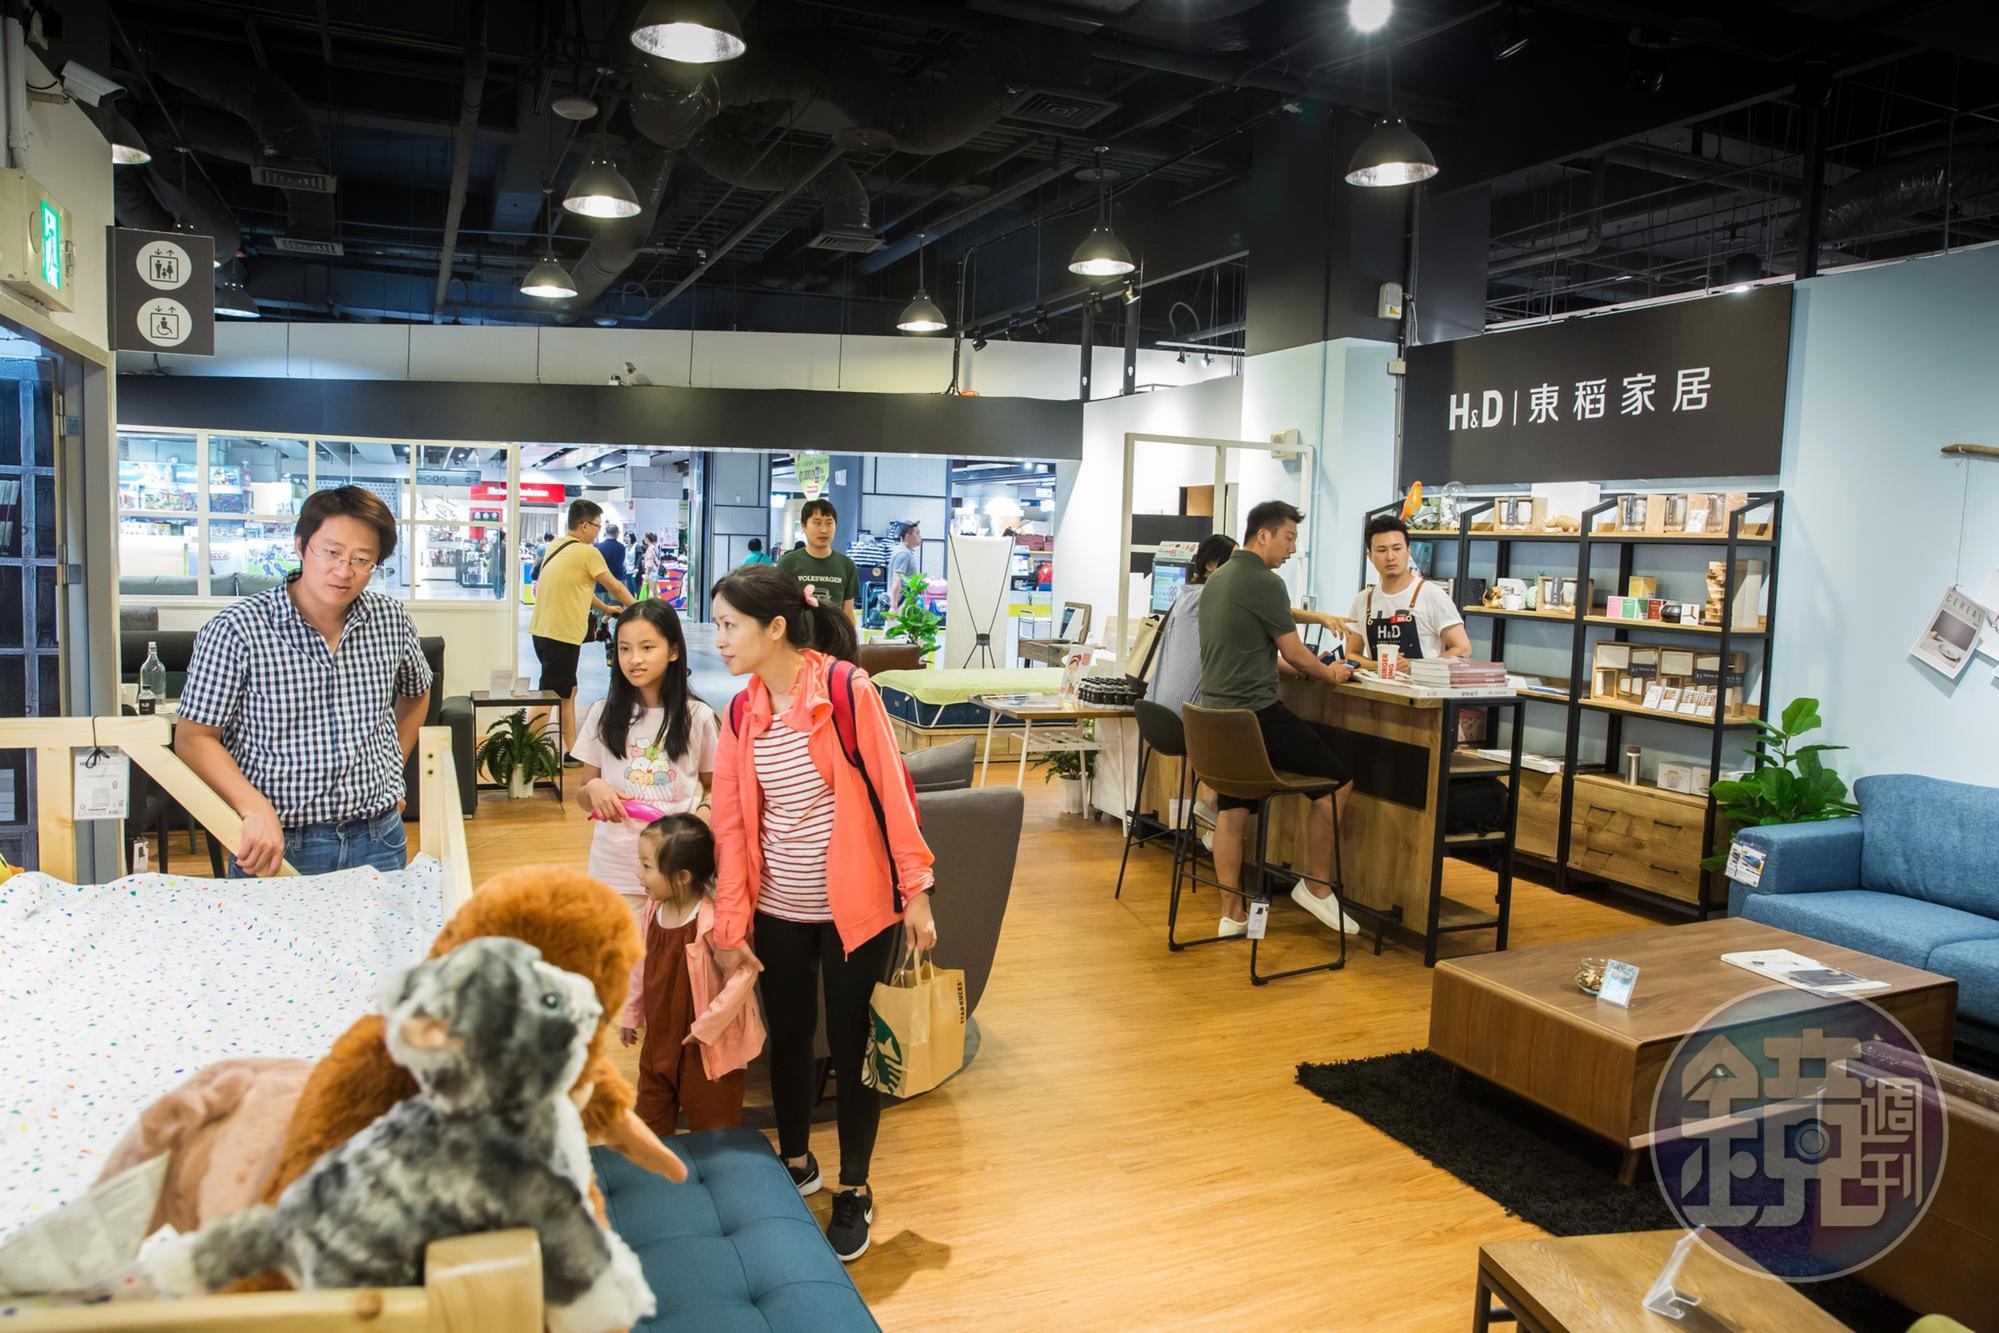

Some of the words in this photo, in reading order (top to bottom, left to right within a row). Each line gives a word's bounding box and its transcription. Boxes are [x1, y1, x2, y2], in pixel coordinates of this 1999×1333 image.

[1448, 389, 1504, 431] H&D
[1528, 366, 1712, 424] 東稻家居
[797, 575, 843, 584] VOLKSWAGEN
[1945, 593, 1983, 623] CEREAL
[1377, 624, 1401, 639] H&D
[957, 981, 965, 1024] STARBUCKS
